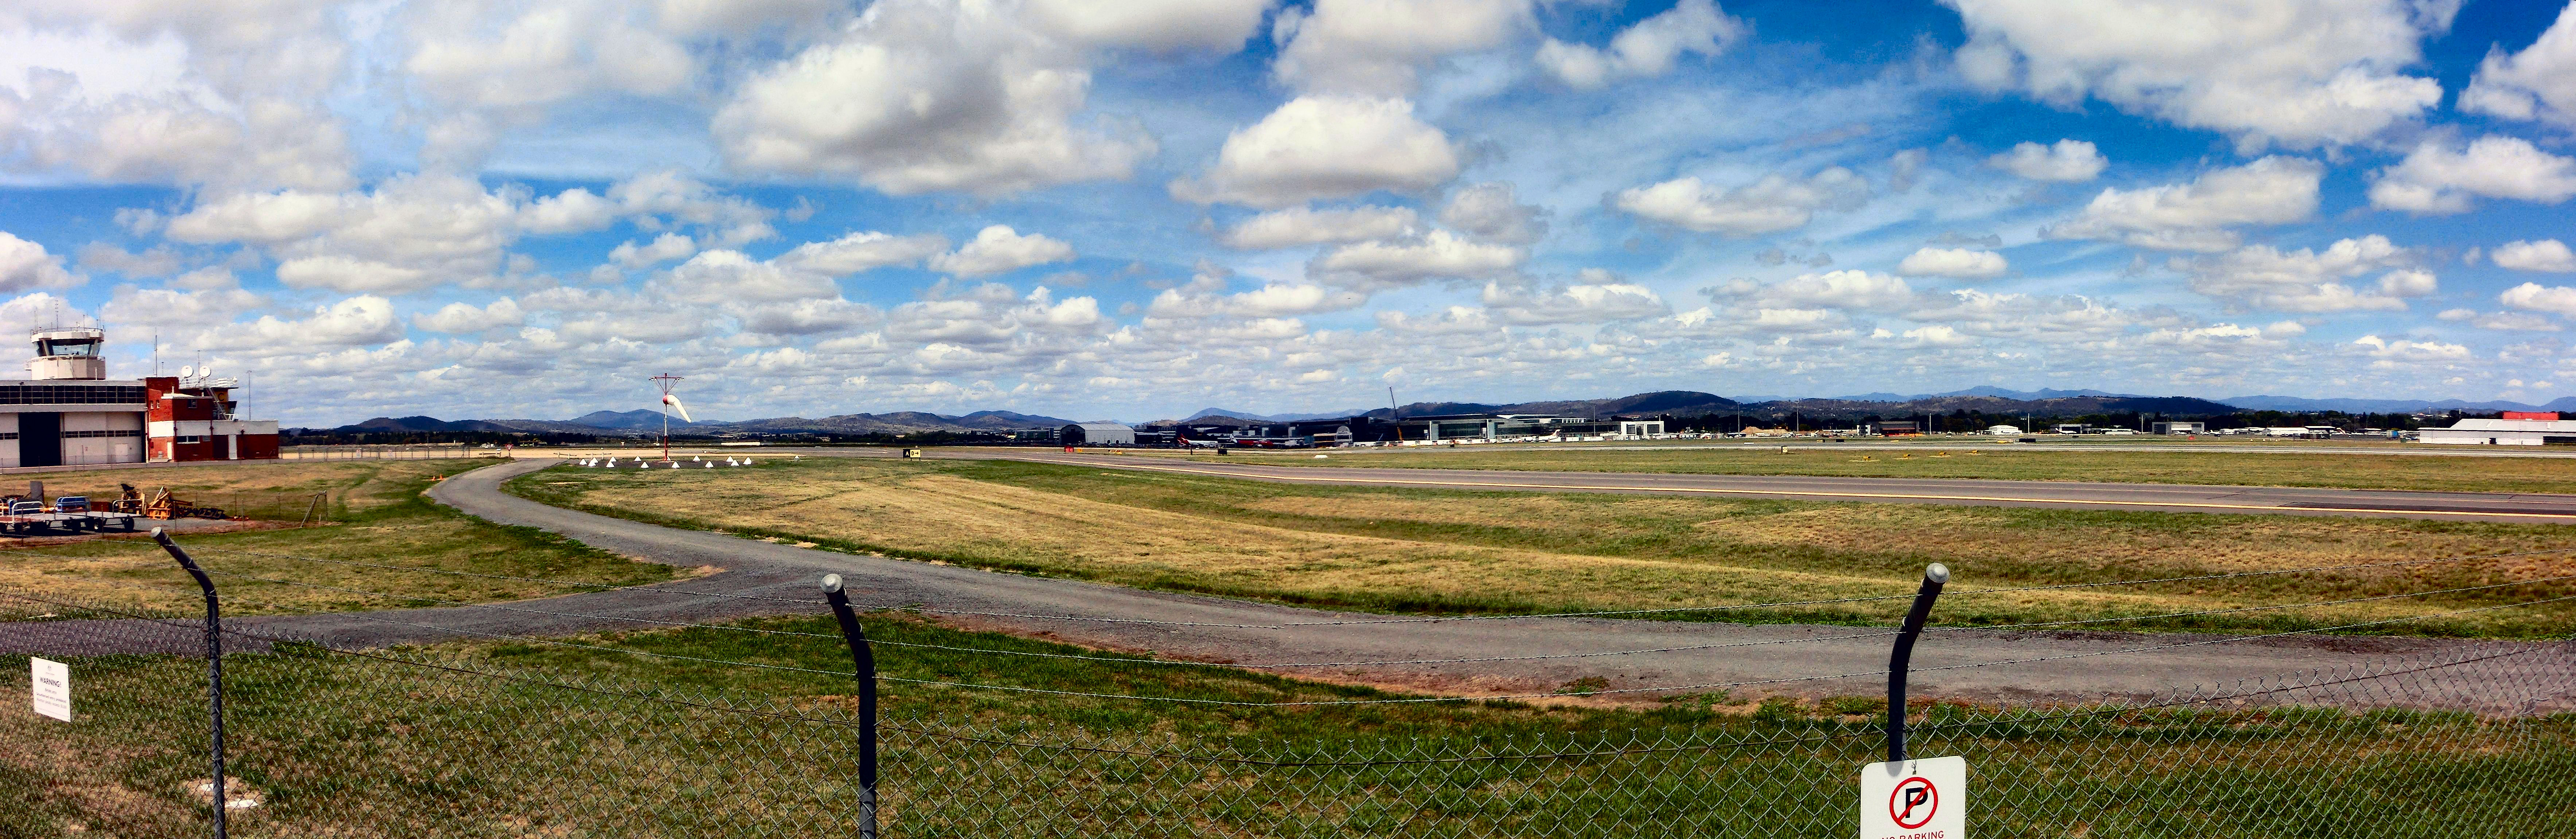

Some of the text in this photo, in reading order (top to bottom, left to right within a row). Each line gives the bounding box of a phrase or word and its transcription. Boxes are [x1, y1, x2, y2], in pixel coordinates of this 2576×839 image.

[218, 393, 224, 401] C
[40, 676, 61, 688] WARNING!
[1905, 787, 1928, 818] P
